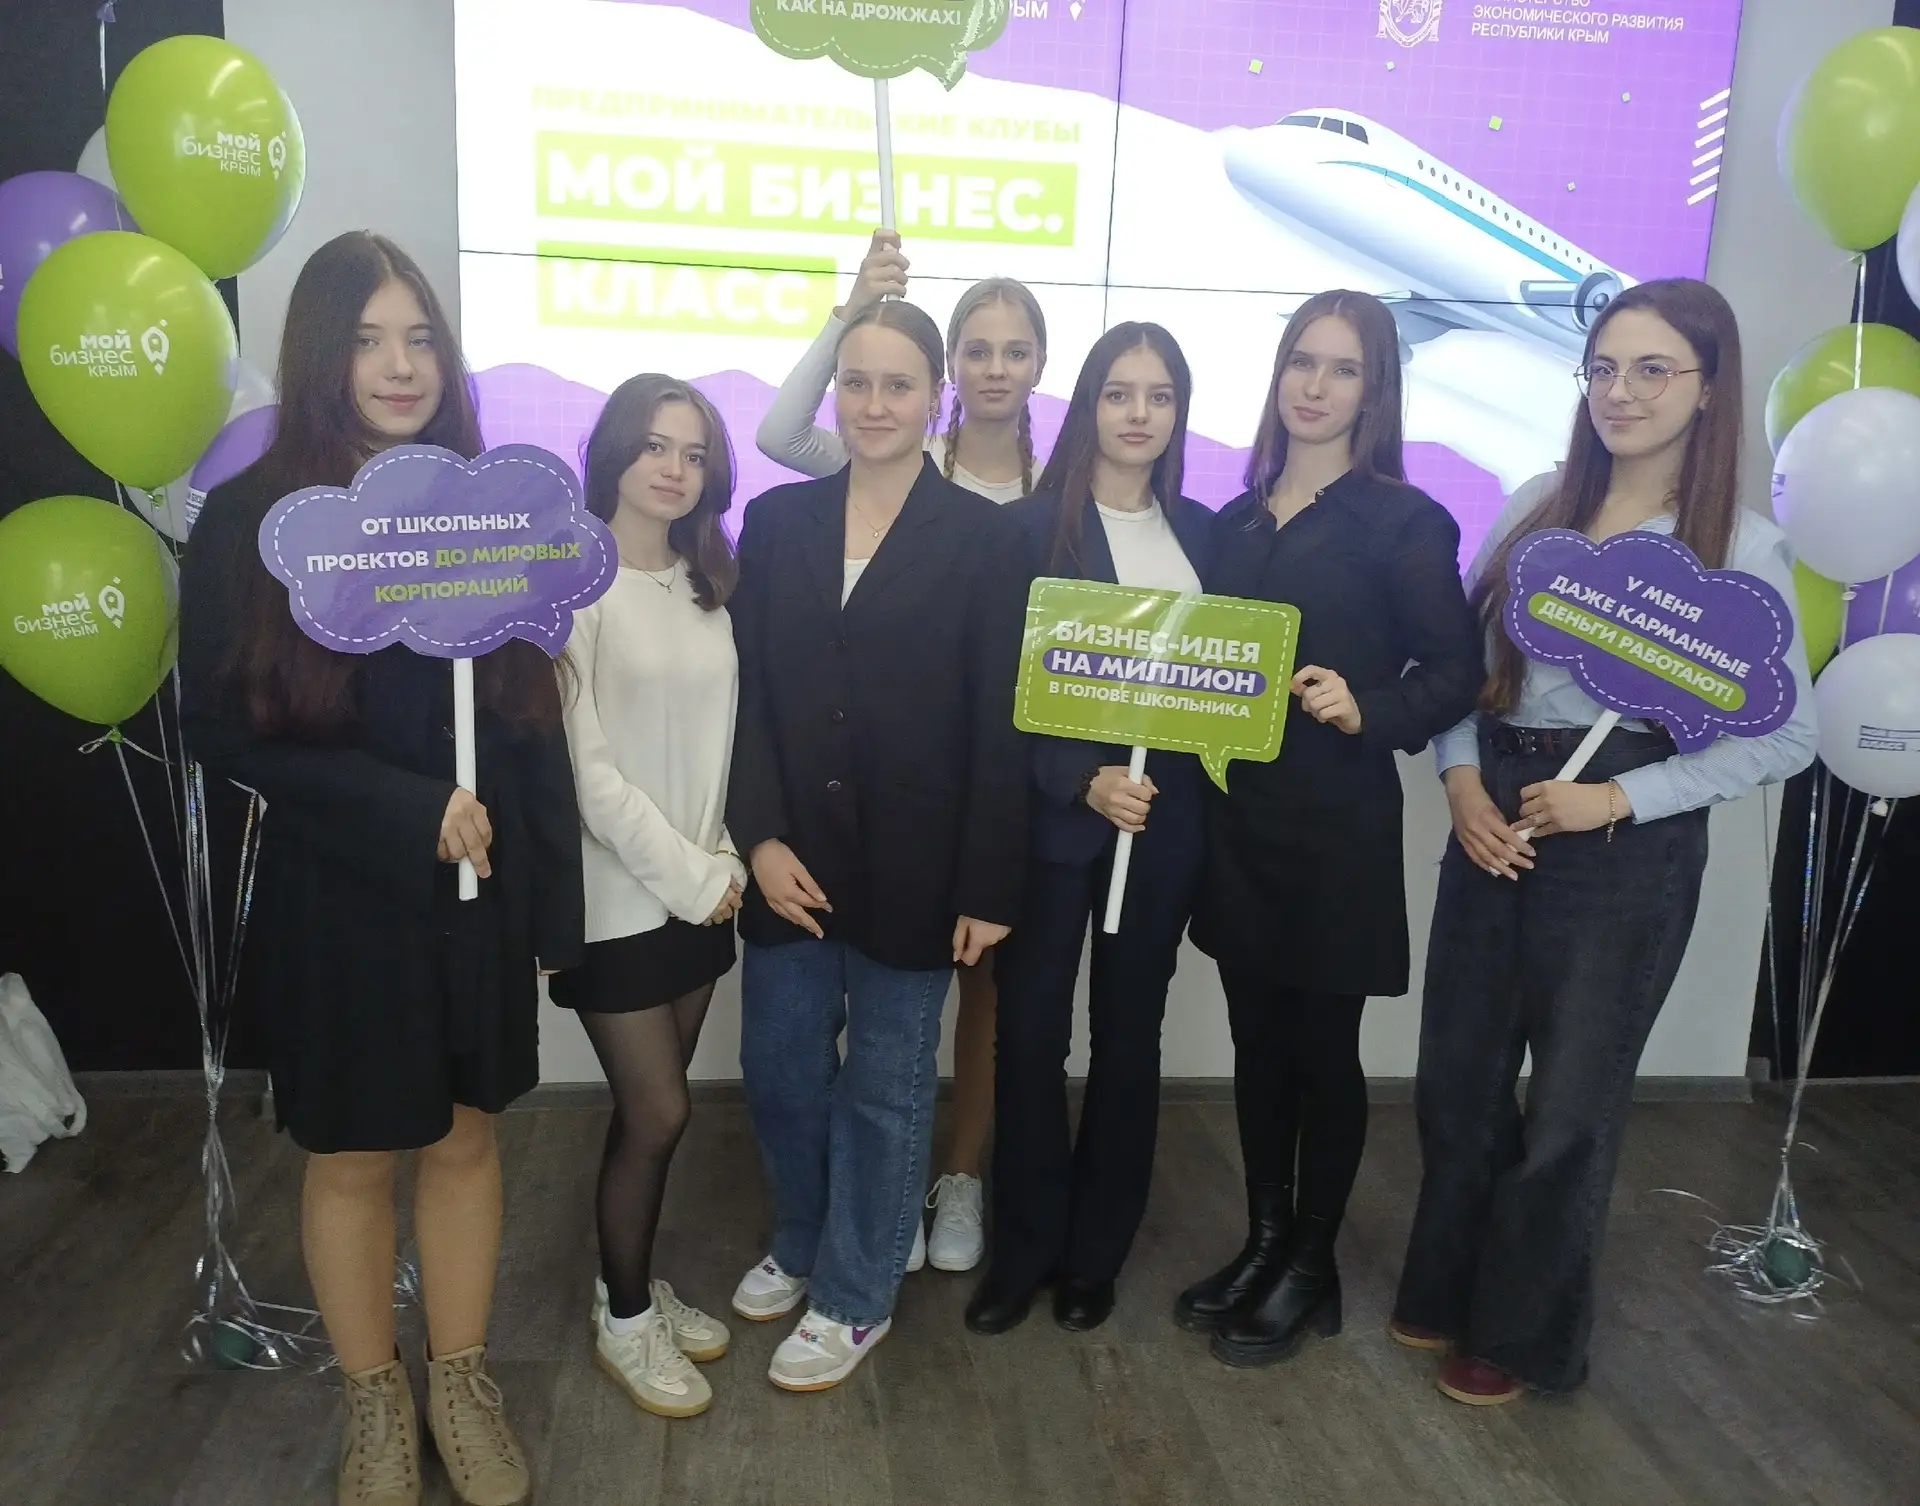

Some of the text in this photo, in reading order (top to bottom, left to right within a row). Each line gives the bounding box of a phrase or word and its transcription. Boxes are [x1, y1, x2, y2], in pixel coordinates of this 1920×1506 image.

[776, 0, 961, 26] КАК НА ДРОЖЖАХ!
[1473, 5, 1684, 31] ЭКОНОМИЧЕСКОГО РАЗВИТИЯ
[1471, 22, 1609, 43] РЕСПУБЛИКИ КРЫМ
[532, 86, 957, 137] ПРЕДПРИНИМАТЕЛЬКИЕ
[182, 135, 260, 165] бизнес
[216, 131, 260, 151] мой
[220, 160, 260, 176] КРЫМ
[546, 142, 1065, 234] МОЙ БИЗНЕС.
[552, 261, 811, 326] КЛАСС
[80, 329, 131, 350] мой
[50, 344, 135, 365] бизнес
[88, 364, 138, 377] КРЫМ
[361, 512, 531, 535] ОТ ШКОЛЬНЫХ
[306, 541, 582, 573] ПРОЕКТОВ ДО МИРОВЫХ
[375, 574, 529, 603] КОРПОРАЦИЙ
[1626, 575, 1704, 623] У МЕНЯ
[42, 592, 91, 616] мой
[14, 611, 95, 634] бизнес
[52, 623, 99, 640] КРЫМ
[1549, 574, 1751, 678] ДАЖЕ КАРМАННЫЕ
[1055, 620, 1261, 664] БИЗНЕС-ИДЕЯ
[1538, 600, 1735, 703] ДЕНЬГИ РАБОТАЮТ!
[1051, 650, 1257, 694] НА МИЛЛИОН
[1049, 681, 1251, 719] В ГОЛОВЕ ШКОЛЬНИКА
